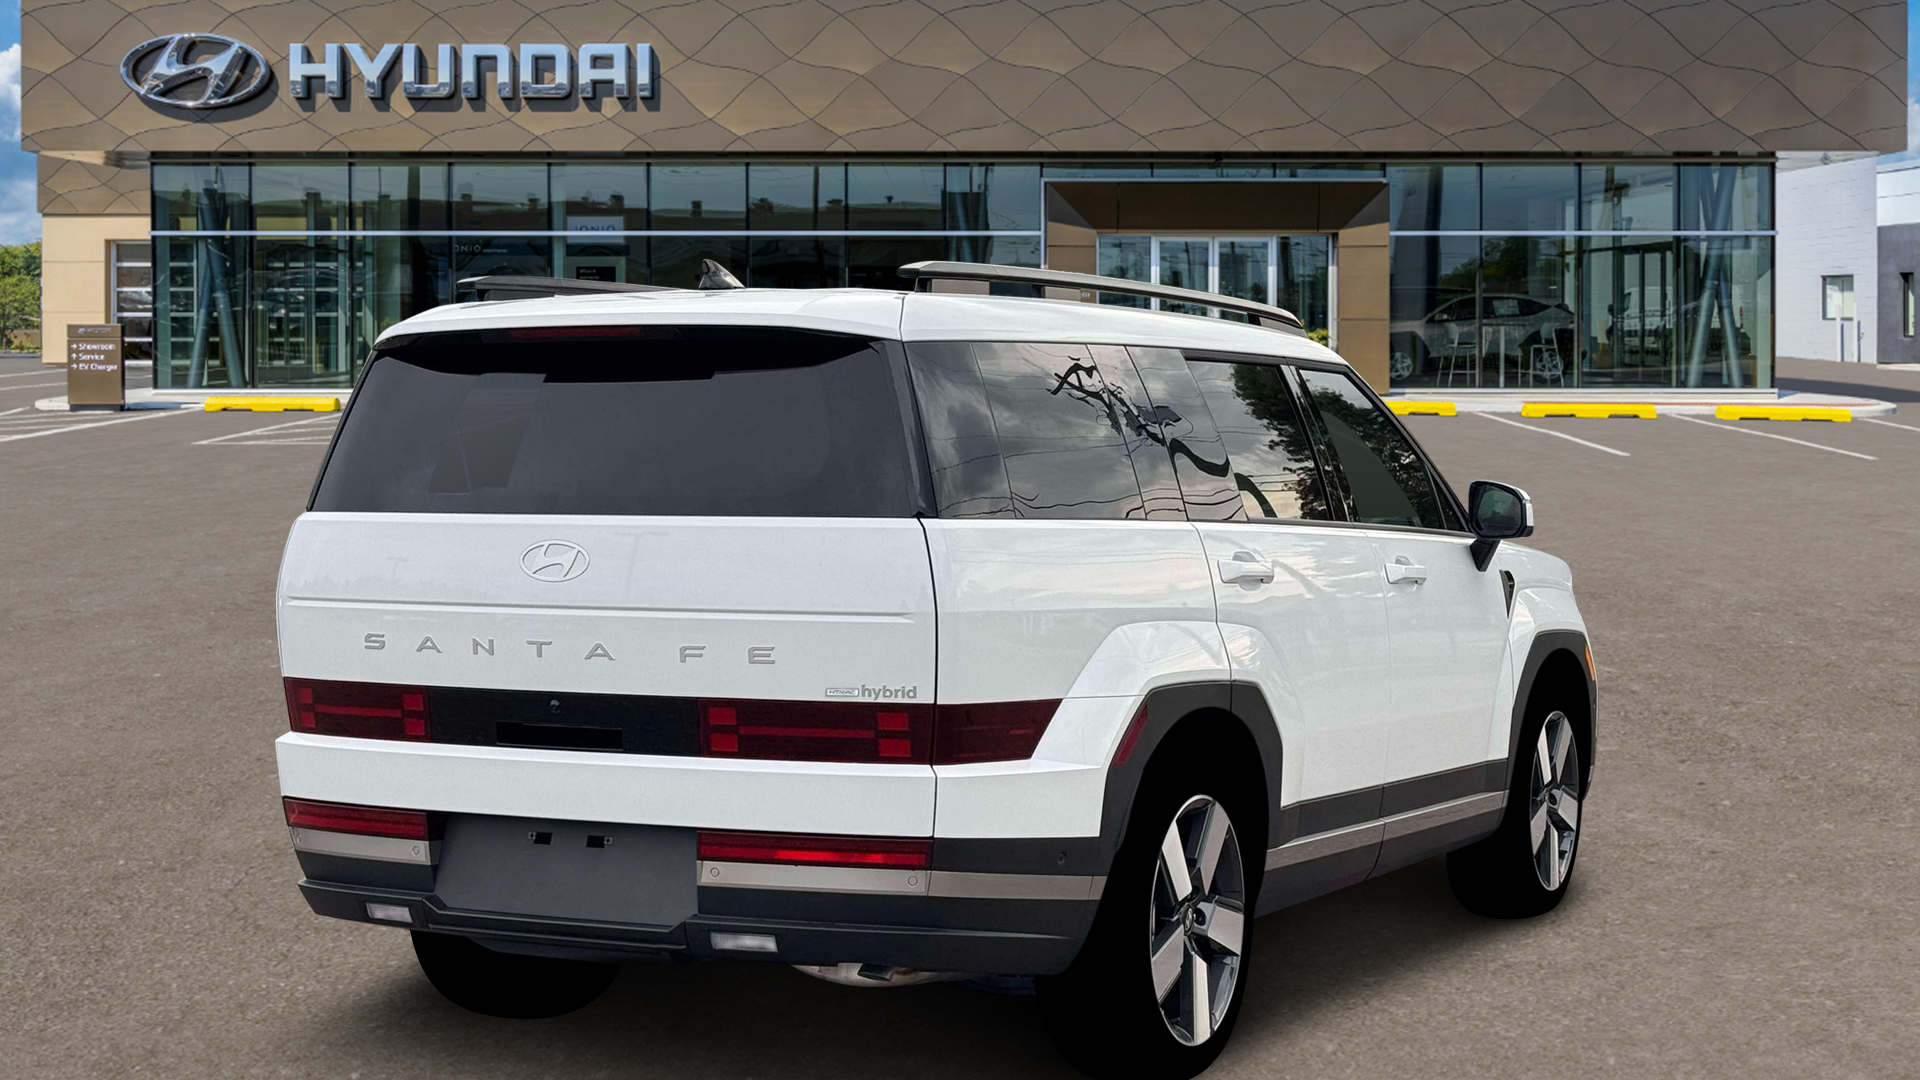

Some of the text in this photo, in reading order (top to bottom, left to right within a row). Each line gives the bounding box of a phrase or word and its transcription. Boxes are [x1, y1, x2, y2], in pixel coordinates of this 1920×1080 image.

[289, 43, 654, 99] HYUNDAI
[78, 343, 116, 351] Showroom
[78, 352, 105, 361] Service
[90, 363, 118, 372] Charger
[364, 632, 776, 665] SANTA FE
[861, 683, 918, 701] hybrid
